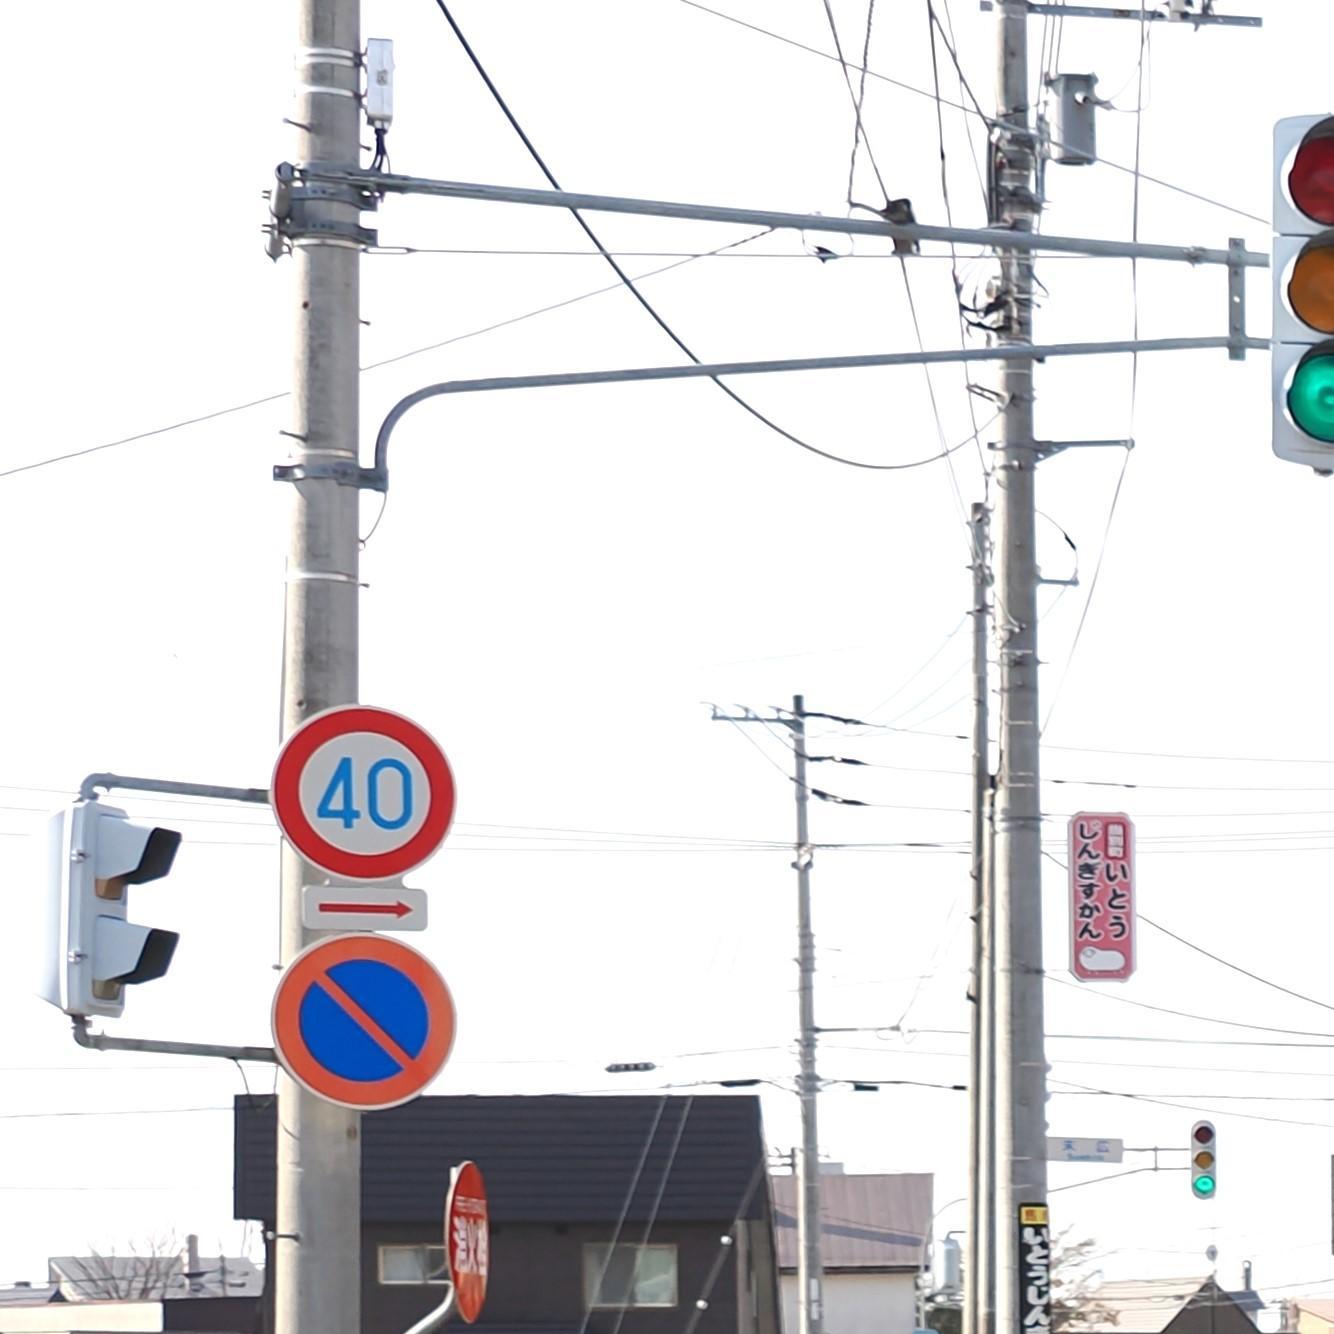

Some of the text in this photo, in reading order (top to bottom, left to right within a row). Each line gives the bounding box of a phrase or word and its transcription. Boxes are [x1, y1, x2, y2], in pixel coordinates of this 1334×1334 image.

[317, 757, 412, 830] 40
[1078, 822, 1101, 939] じんぎすかん
[1105, 863, 1128, 938] いとう
